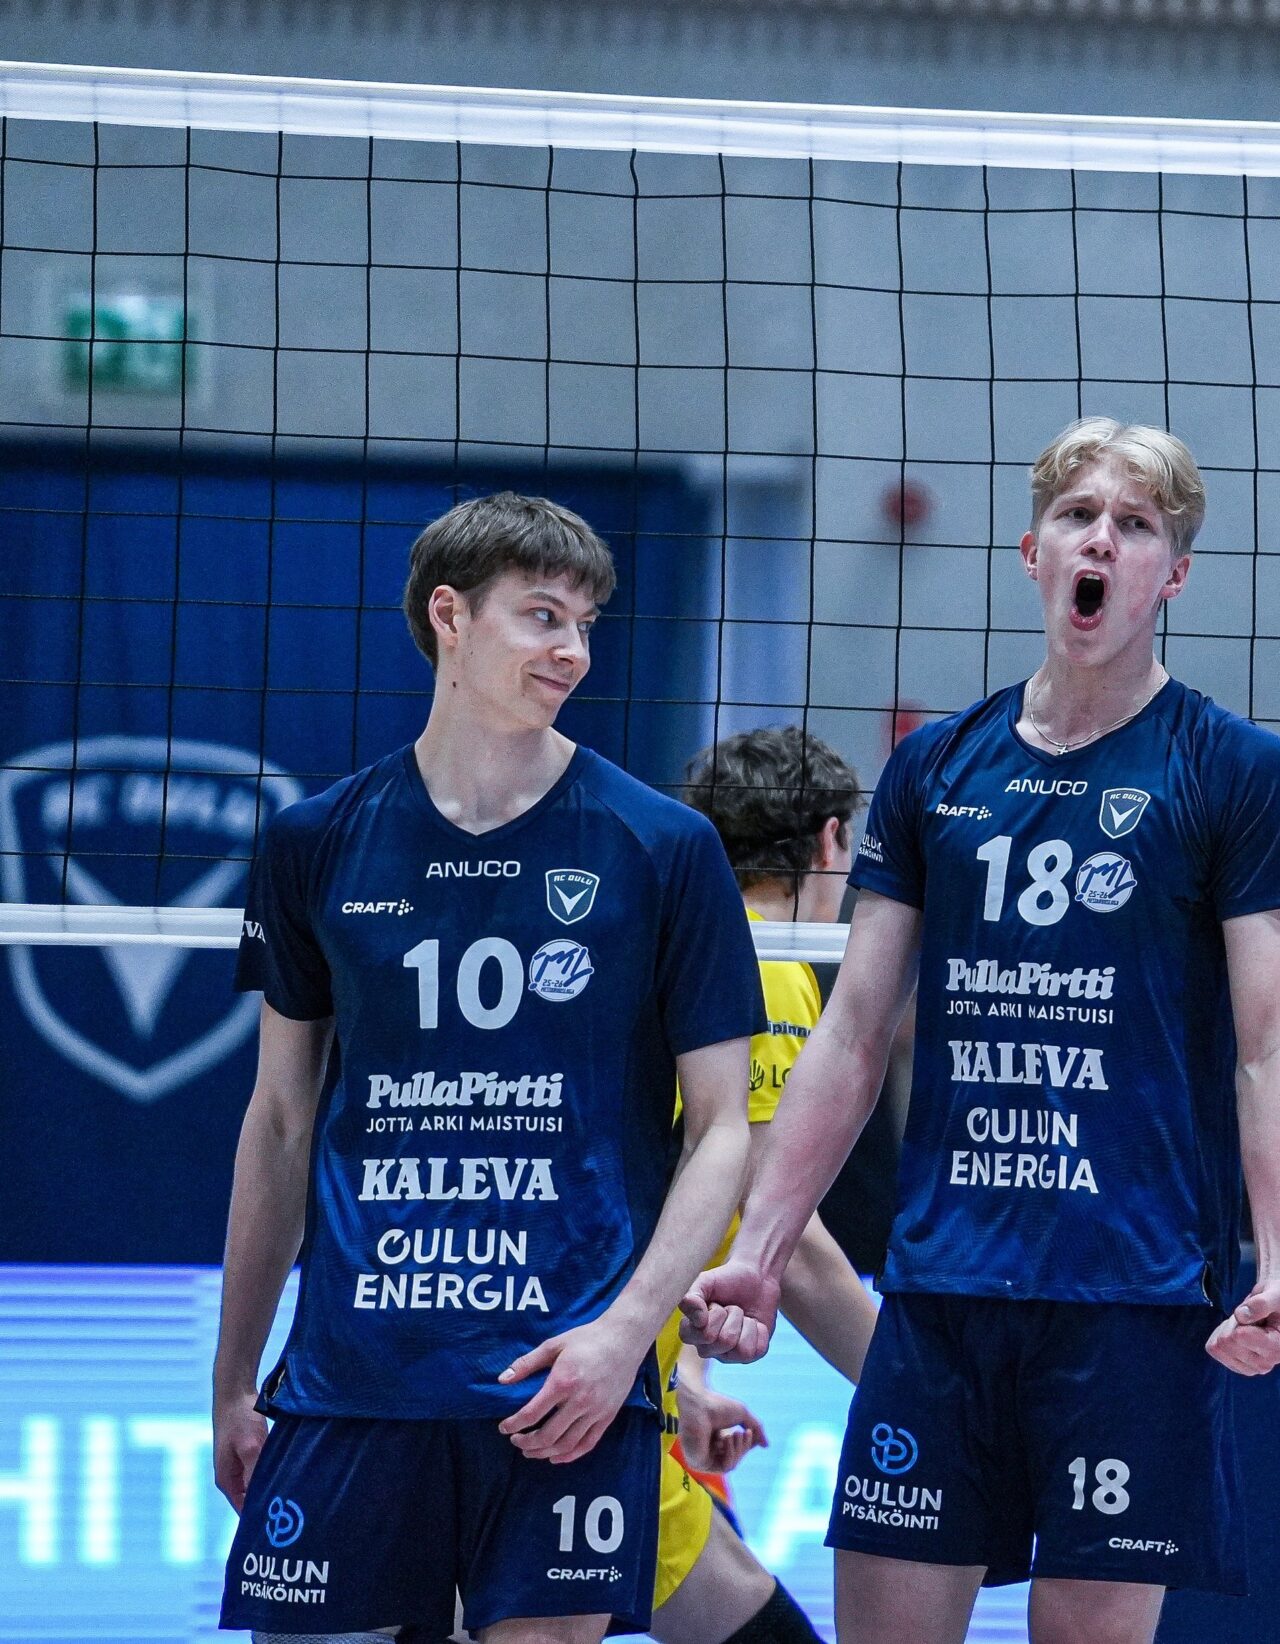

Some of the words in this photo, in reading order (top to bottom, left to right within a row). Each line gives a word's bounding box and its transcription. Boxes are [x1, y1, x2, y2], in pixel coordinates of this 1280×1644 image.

[1005, 778, 1088, 796] ANUCO
[1122, 793, 1145, 803] OULU
[935, 803, 979, 817] RAFT
[426, 860, 521, 878] ANUCO
[567, 874, 593, 886] OULU
[976, 835, 1073, 926] 18
[341, 901, 398, 914] CRAFT
[403, 936, 524, 1029] 10
[946, 958, 1116, 1000] PullaPirtti
[946, 1000, 981, 1015] JOTTA
[988, 1002, 1021, 1018] ARKI
[948, 1040, 1109, 1090] KALEVA
[366, 1071, 564, 1108] PullaPirtti
[366, 1117, 413, 1132] JOTTA
[420, 1115, 463, 1131] ARKI
[470, 1115, 563, 1132] MAISTUISI
[966, 1106, 1078, 1147] OULUN
[358, 1157, 560, 1201] KALEVA
[950, 1150, 1099, 1194] ENERGIA
[377, 1228, 527, 1265] OULUN
[354, 1272, 550, 1312] ENERGIA
[845, 1475, 942, 1511] OULUN
[1068, 1457, 1130, 1515] 18
[552, 1495, 624, 1553] 10
[842, 1501, 939, 1530] PYSÄKÖINTI
[1108, 1537, 1166, 1552] CRAFT
[243, 1553, 330, 1584] OULUN
[546, 1567, 609, 1580] CRAFT
[241, 1580, 326, 1603] PYSÄKÖINTI
